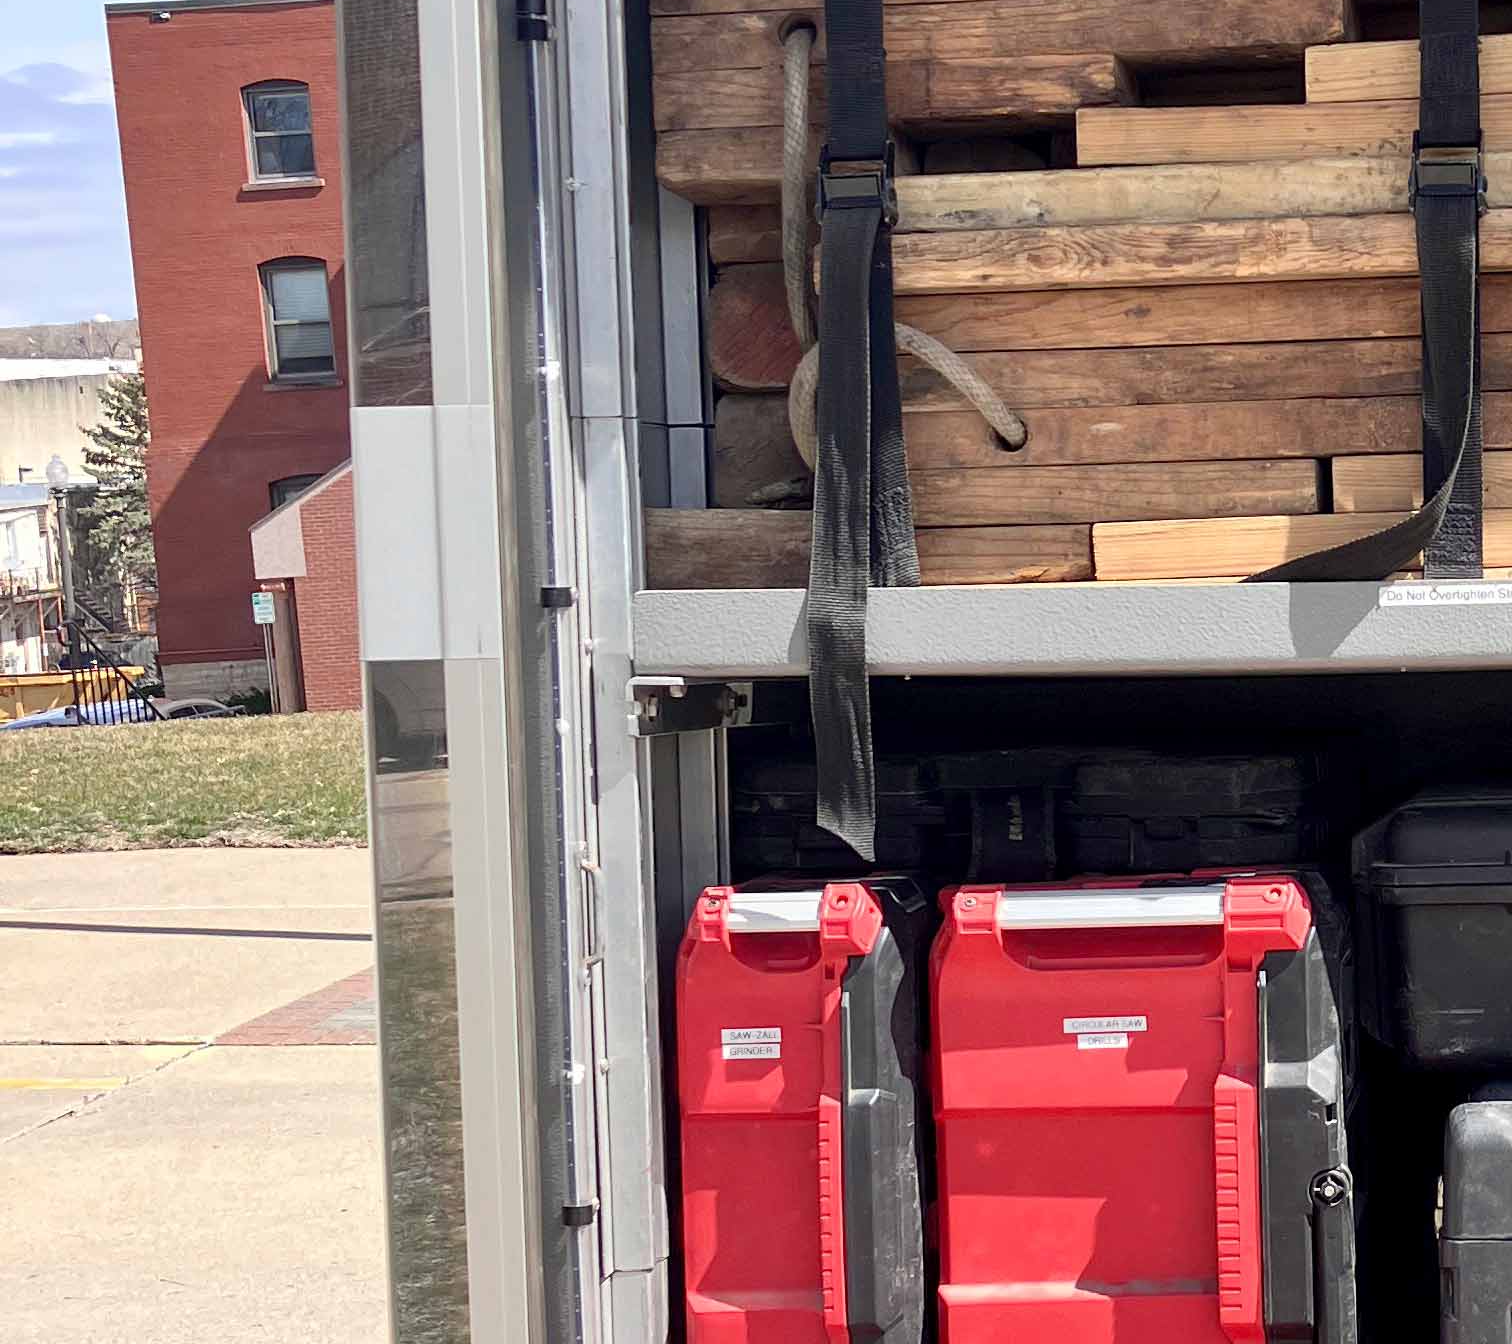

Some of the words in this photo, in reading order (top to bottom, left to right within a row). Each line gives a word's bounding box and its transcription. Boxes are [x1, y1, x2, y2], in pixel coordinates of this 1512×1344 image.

[1387, 590, 1402, 601] Do
[1406, 589, 1426, 601] Not
[1429, 589, 1495, 602] Overtighten
